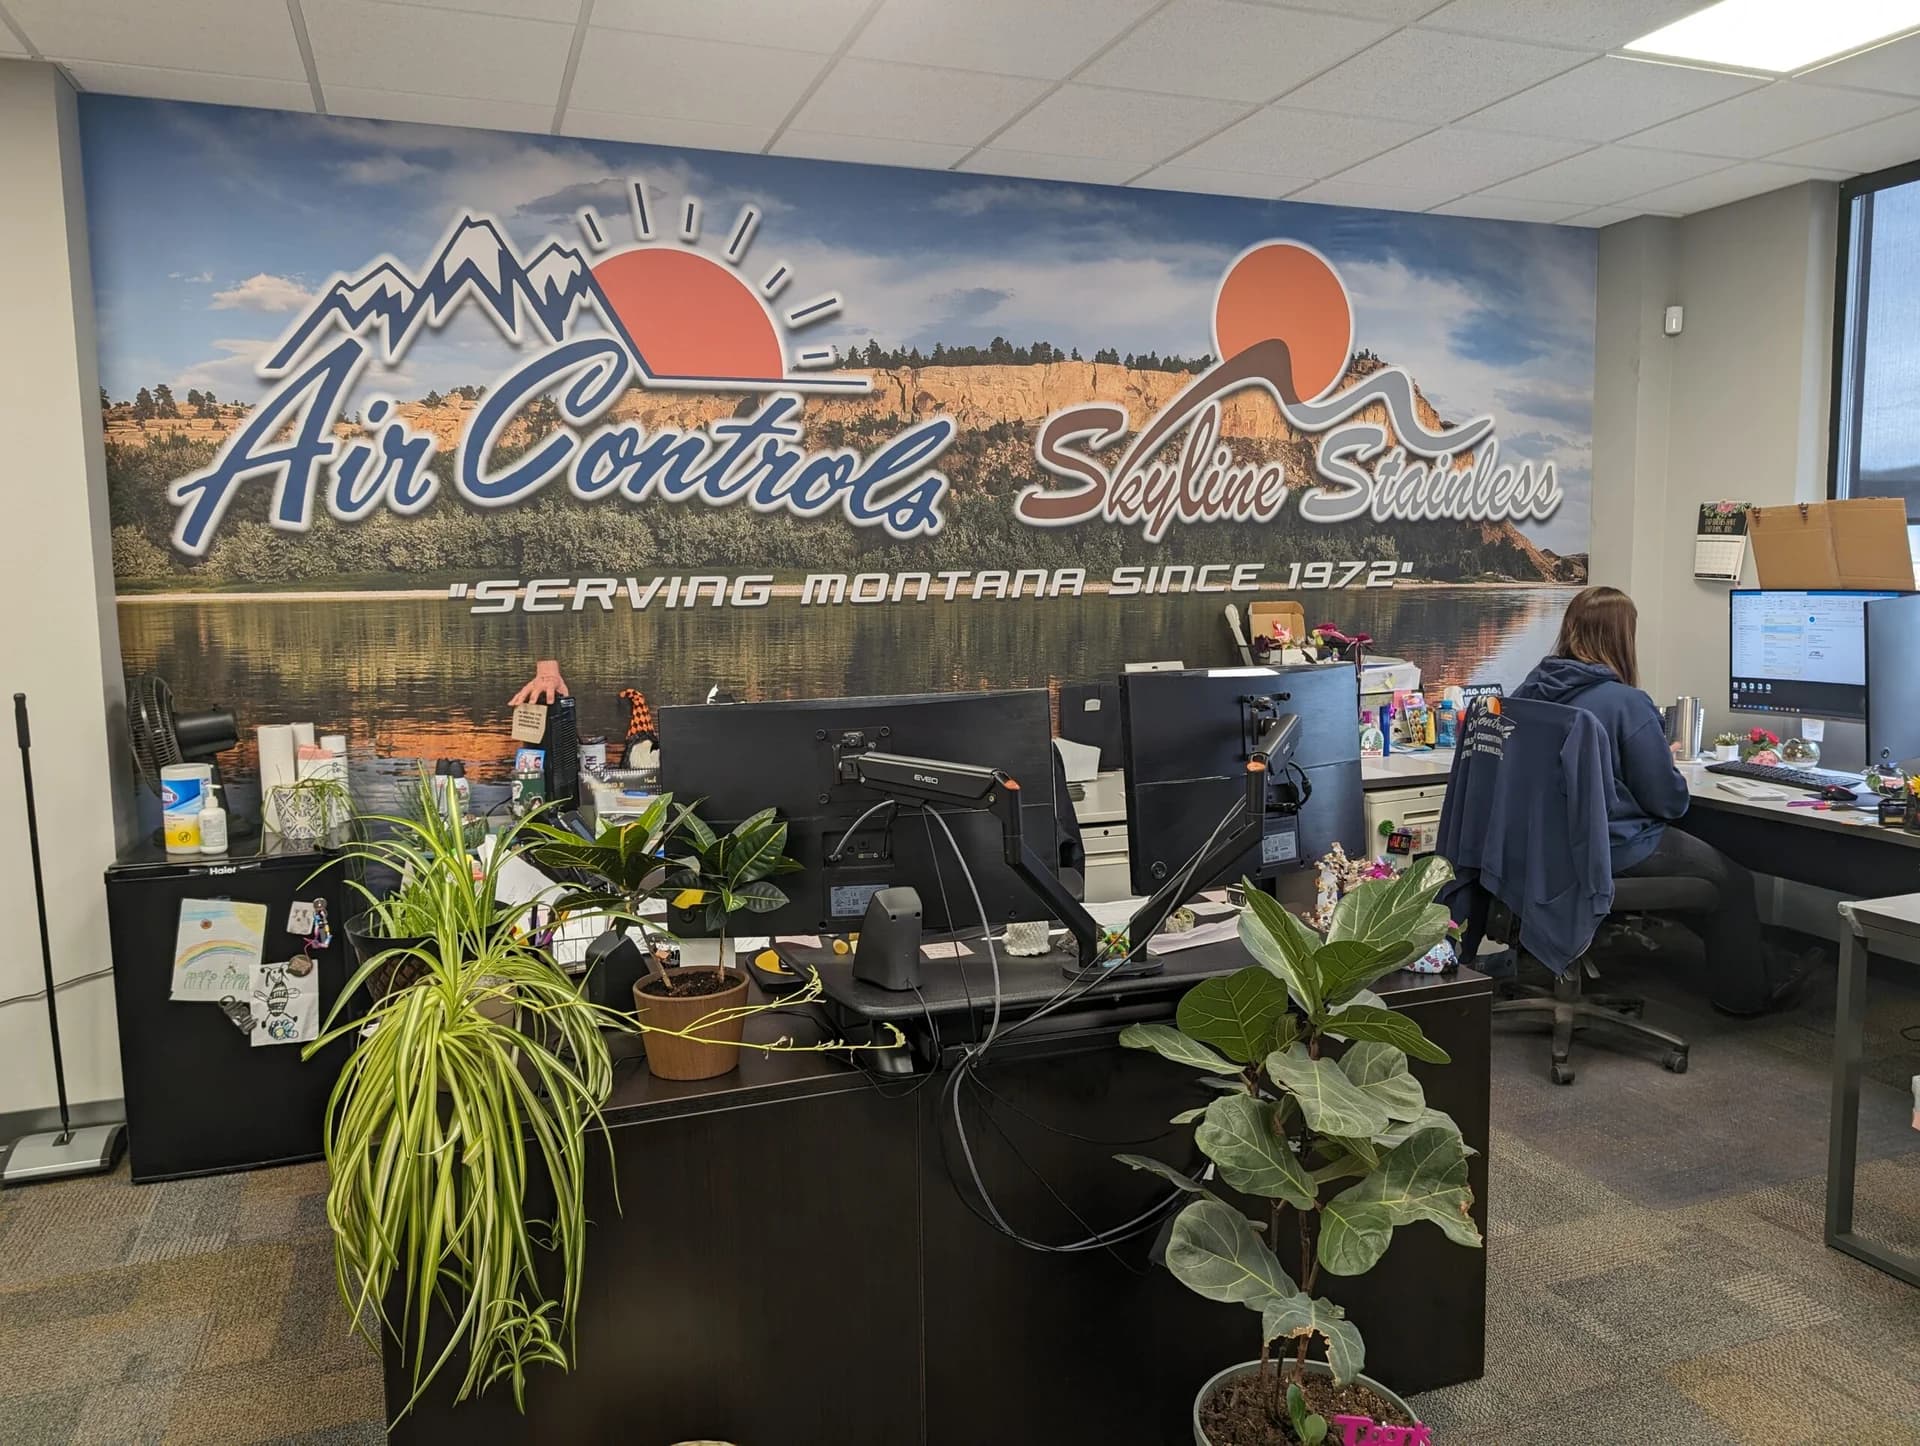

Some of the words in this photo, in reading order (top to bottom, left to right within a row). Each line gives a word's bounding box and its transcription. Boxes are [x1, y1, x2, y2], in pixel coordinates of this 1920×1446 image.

[174, 338, 435, 548] Air
[460, 337, 951, 534] Controls
[1019, 402, 1282, 537] Skyline
[1303, 427, 1560, 521] Stainless
[449, 574, 772, 614] "SERVING
[801, 567, 1086, 605] MONTANA
[1108, 563, 1265, 595] SINCE
[1289, 560, 1414, 590] 1972"
[209, 866, 237, 876] Haier
